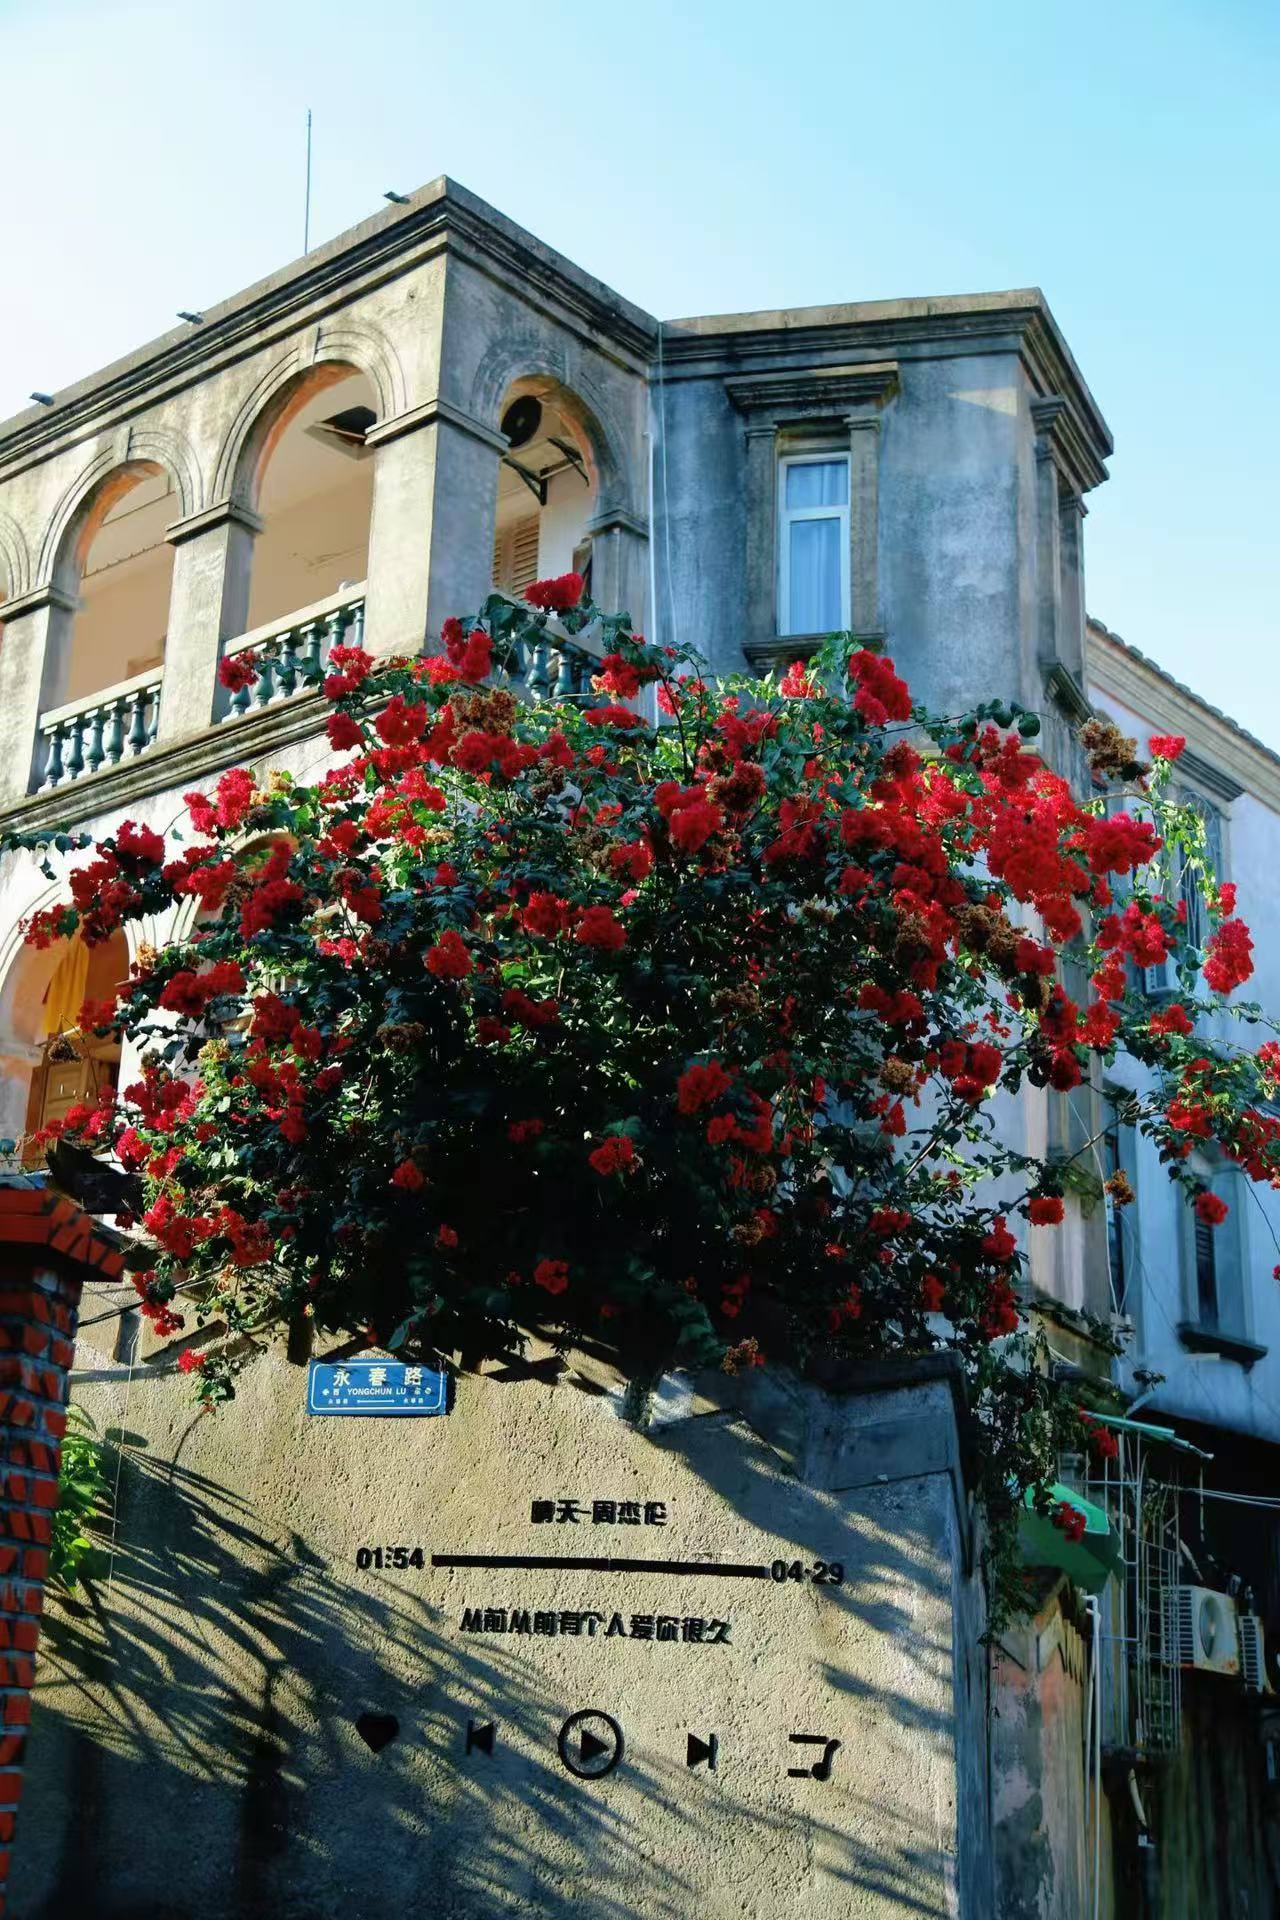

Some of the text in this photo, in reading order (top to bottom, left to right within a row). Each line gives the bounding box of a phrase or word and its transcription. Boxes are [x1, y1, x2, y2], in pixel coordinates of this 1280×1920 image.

[333, 1367, 424, 1387] 永春路
[347, 1387, 407, 1396] YONGCHUN LU
[356, 1546, 426, 1570] 01:54
[458, 1607, 733, 1646] 从前从前有个人爱你很久
